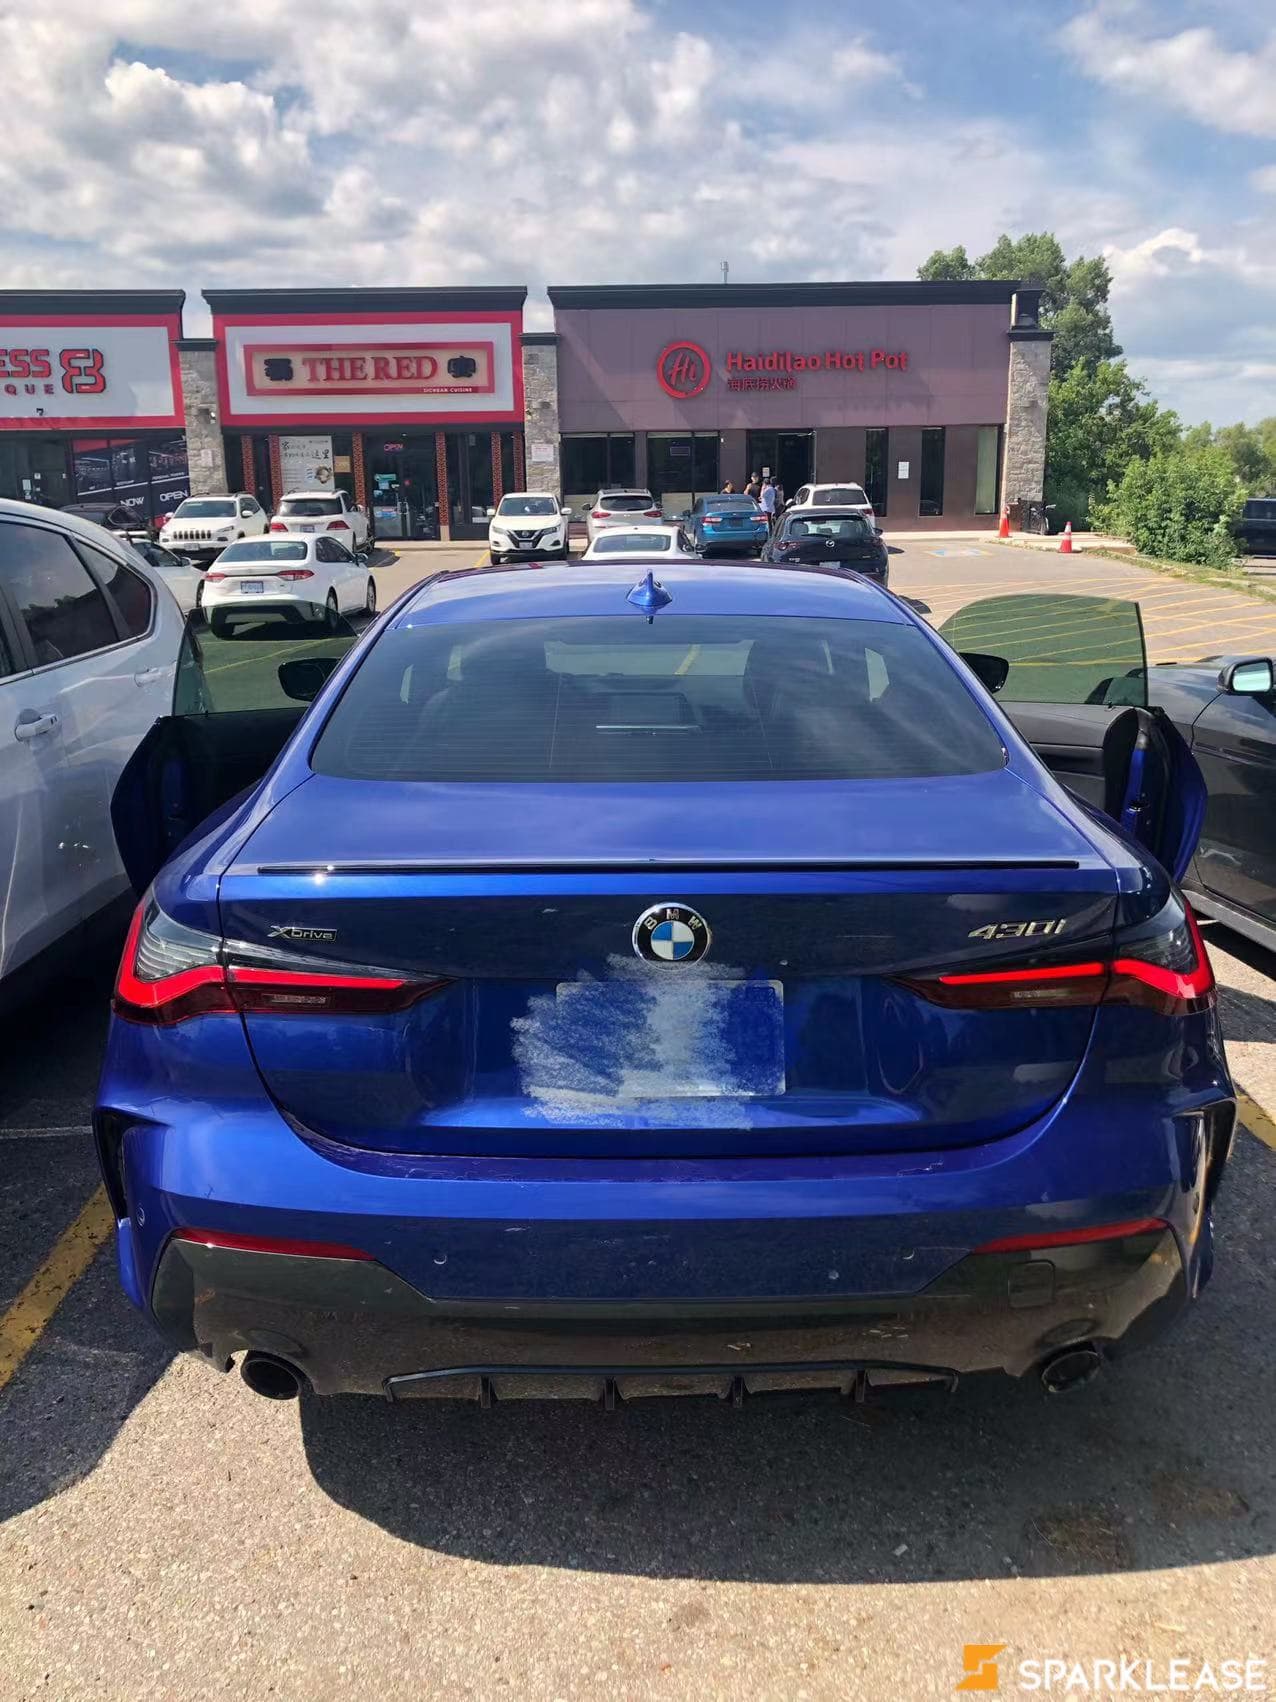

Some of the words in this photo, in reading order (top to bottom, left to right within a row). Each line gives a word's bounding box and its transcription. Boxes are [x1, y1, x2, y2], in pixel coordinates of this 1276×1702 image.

[302, 356, 369, 383] THE
[371, 355, 439, 381] RED
[726, 351, 821, 373] Haidilao
[825, 351, 866, 372] Hot
[870, 349, 909, 371] Pot
[36, 407, 44, 416] 7
[119, 496, 145, 507] NOW
[159, 489, 188, 502] OPEN
[643, 908, 702, 931] BMW
